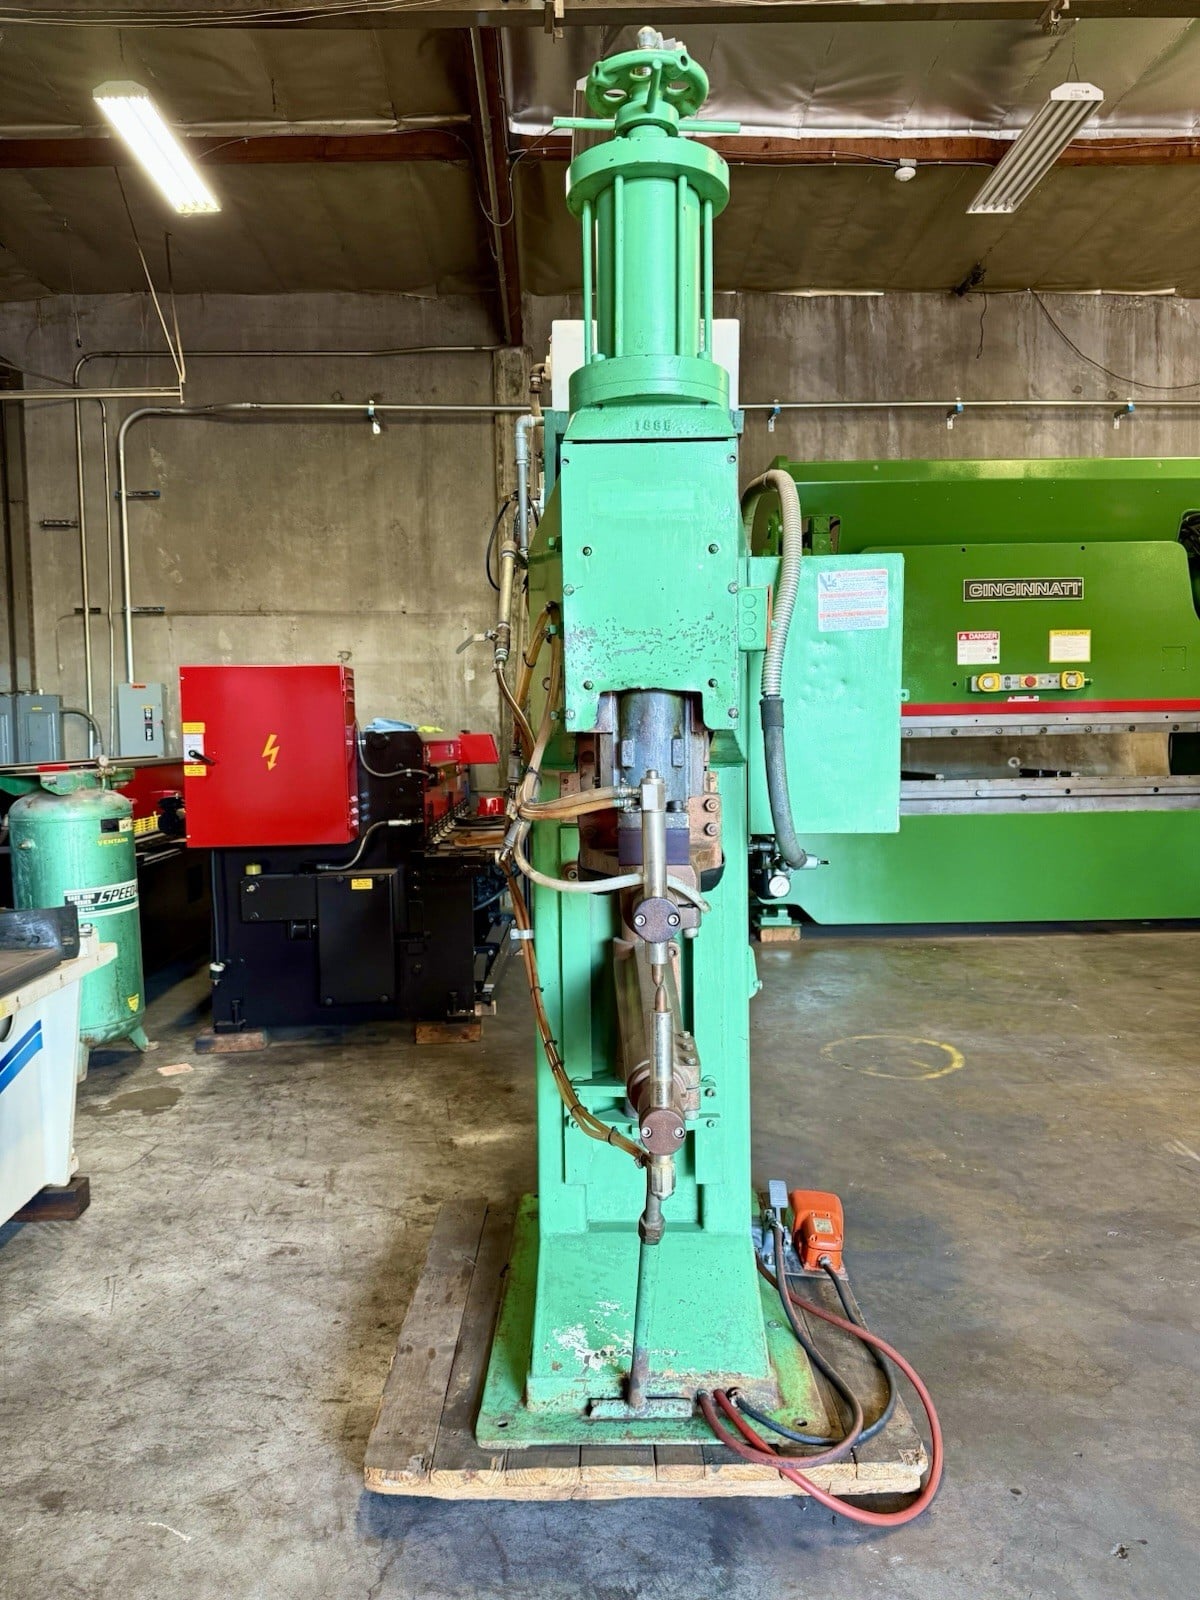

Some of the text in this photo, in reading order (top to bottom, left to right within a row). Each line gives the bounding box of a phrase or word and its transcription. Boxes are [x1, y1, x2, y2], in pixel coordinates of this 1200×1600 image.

[969, 582, 1079, 598] CINCINNATI
[969, 632, 998, 640] DANGER
[101, 884, 137, 904] SPEED
